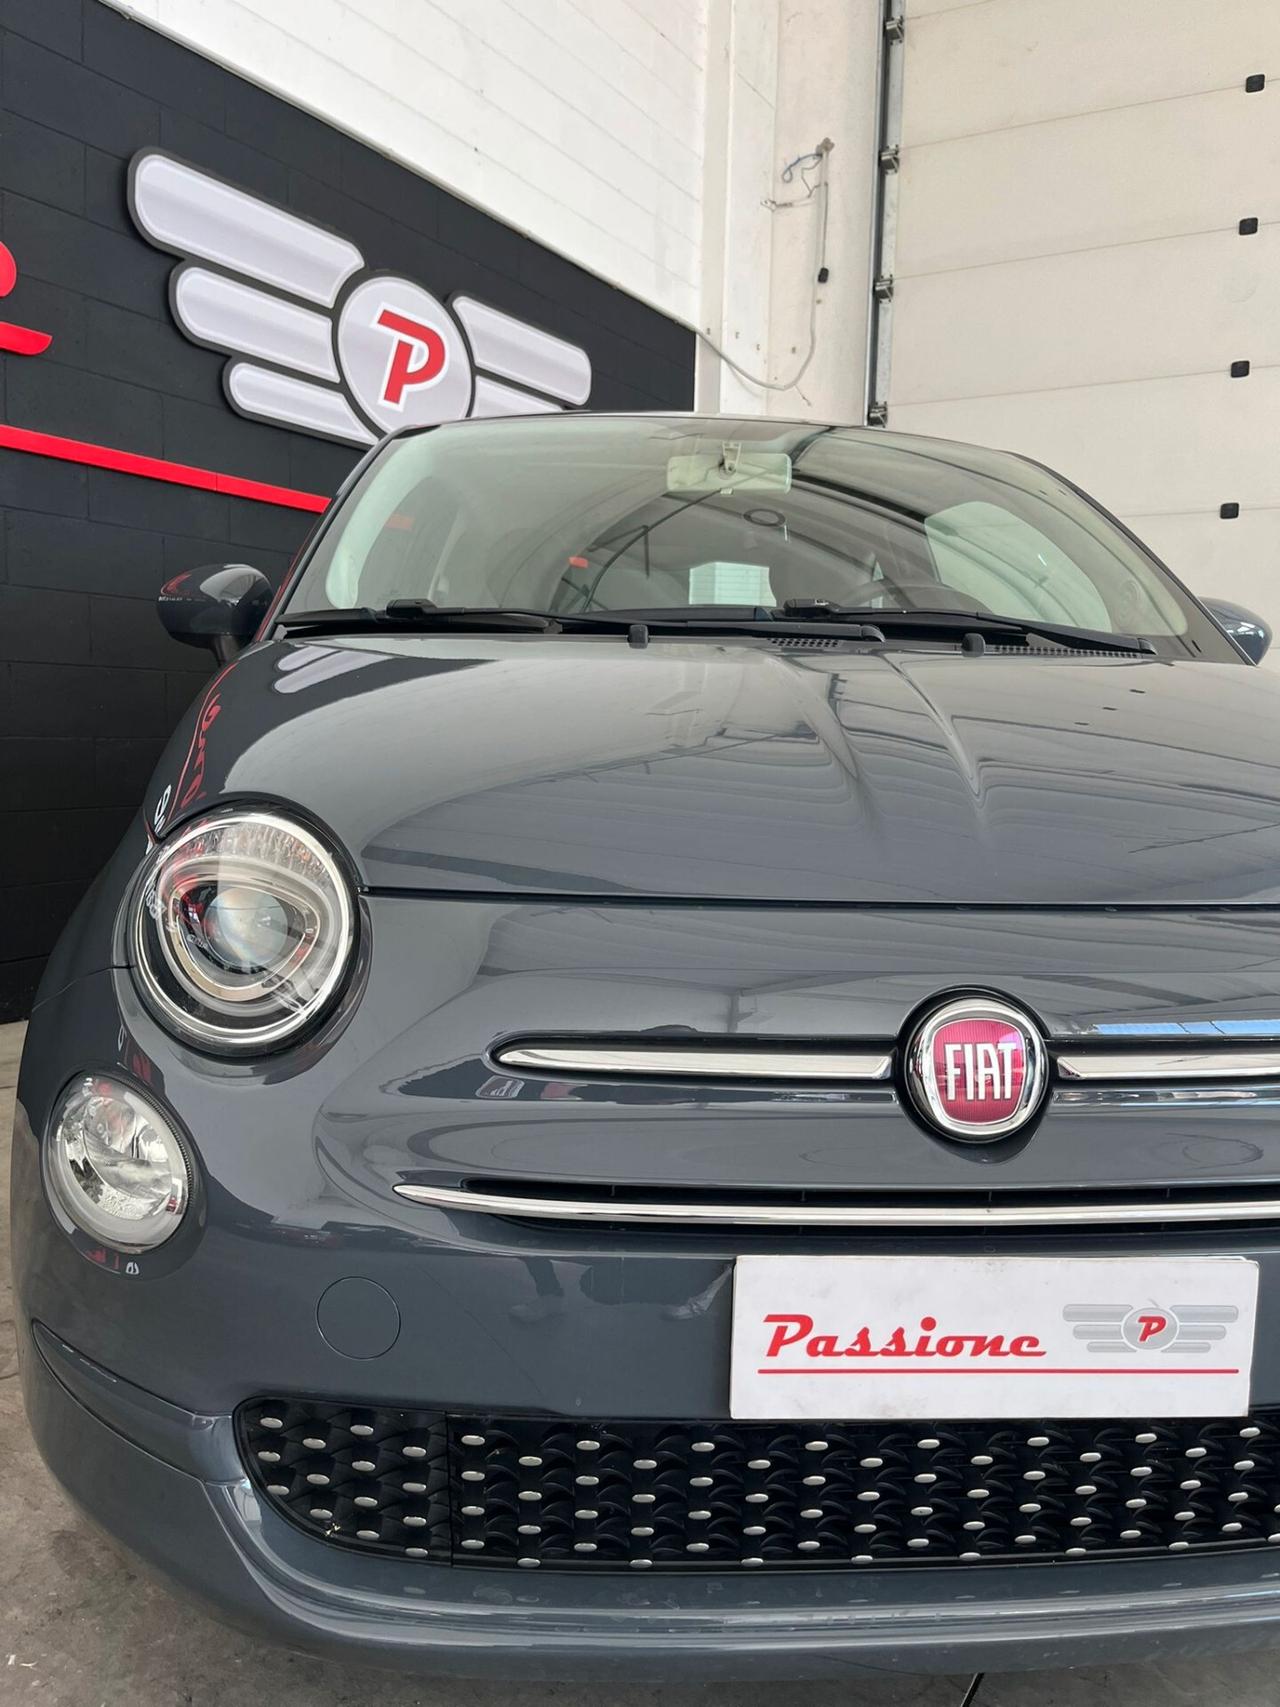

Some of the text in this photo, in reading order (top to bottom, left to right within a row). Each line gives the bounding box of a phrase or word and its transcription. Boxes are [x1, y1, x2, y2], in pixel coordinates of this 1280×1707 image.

[376, 308, 447, 406] P
[944, 1042, 1017, 1101] FIAT
[763, 1313, 1046, 1359] Passione
[1137, 1314, 1167, 1343] P
